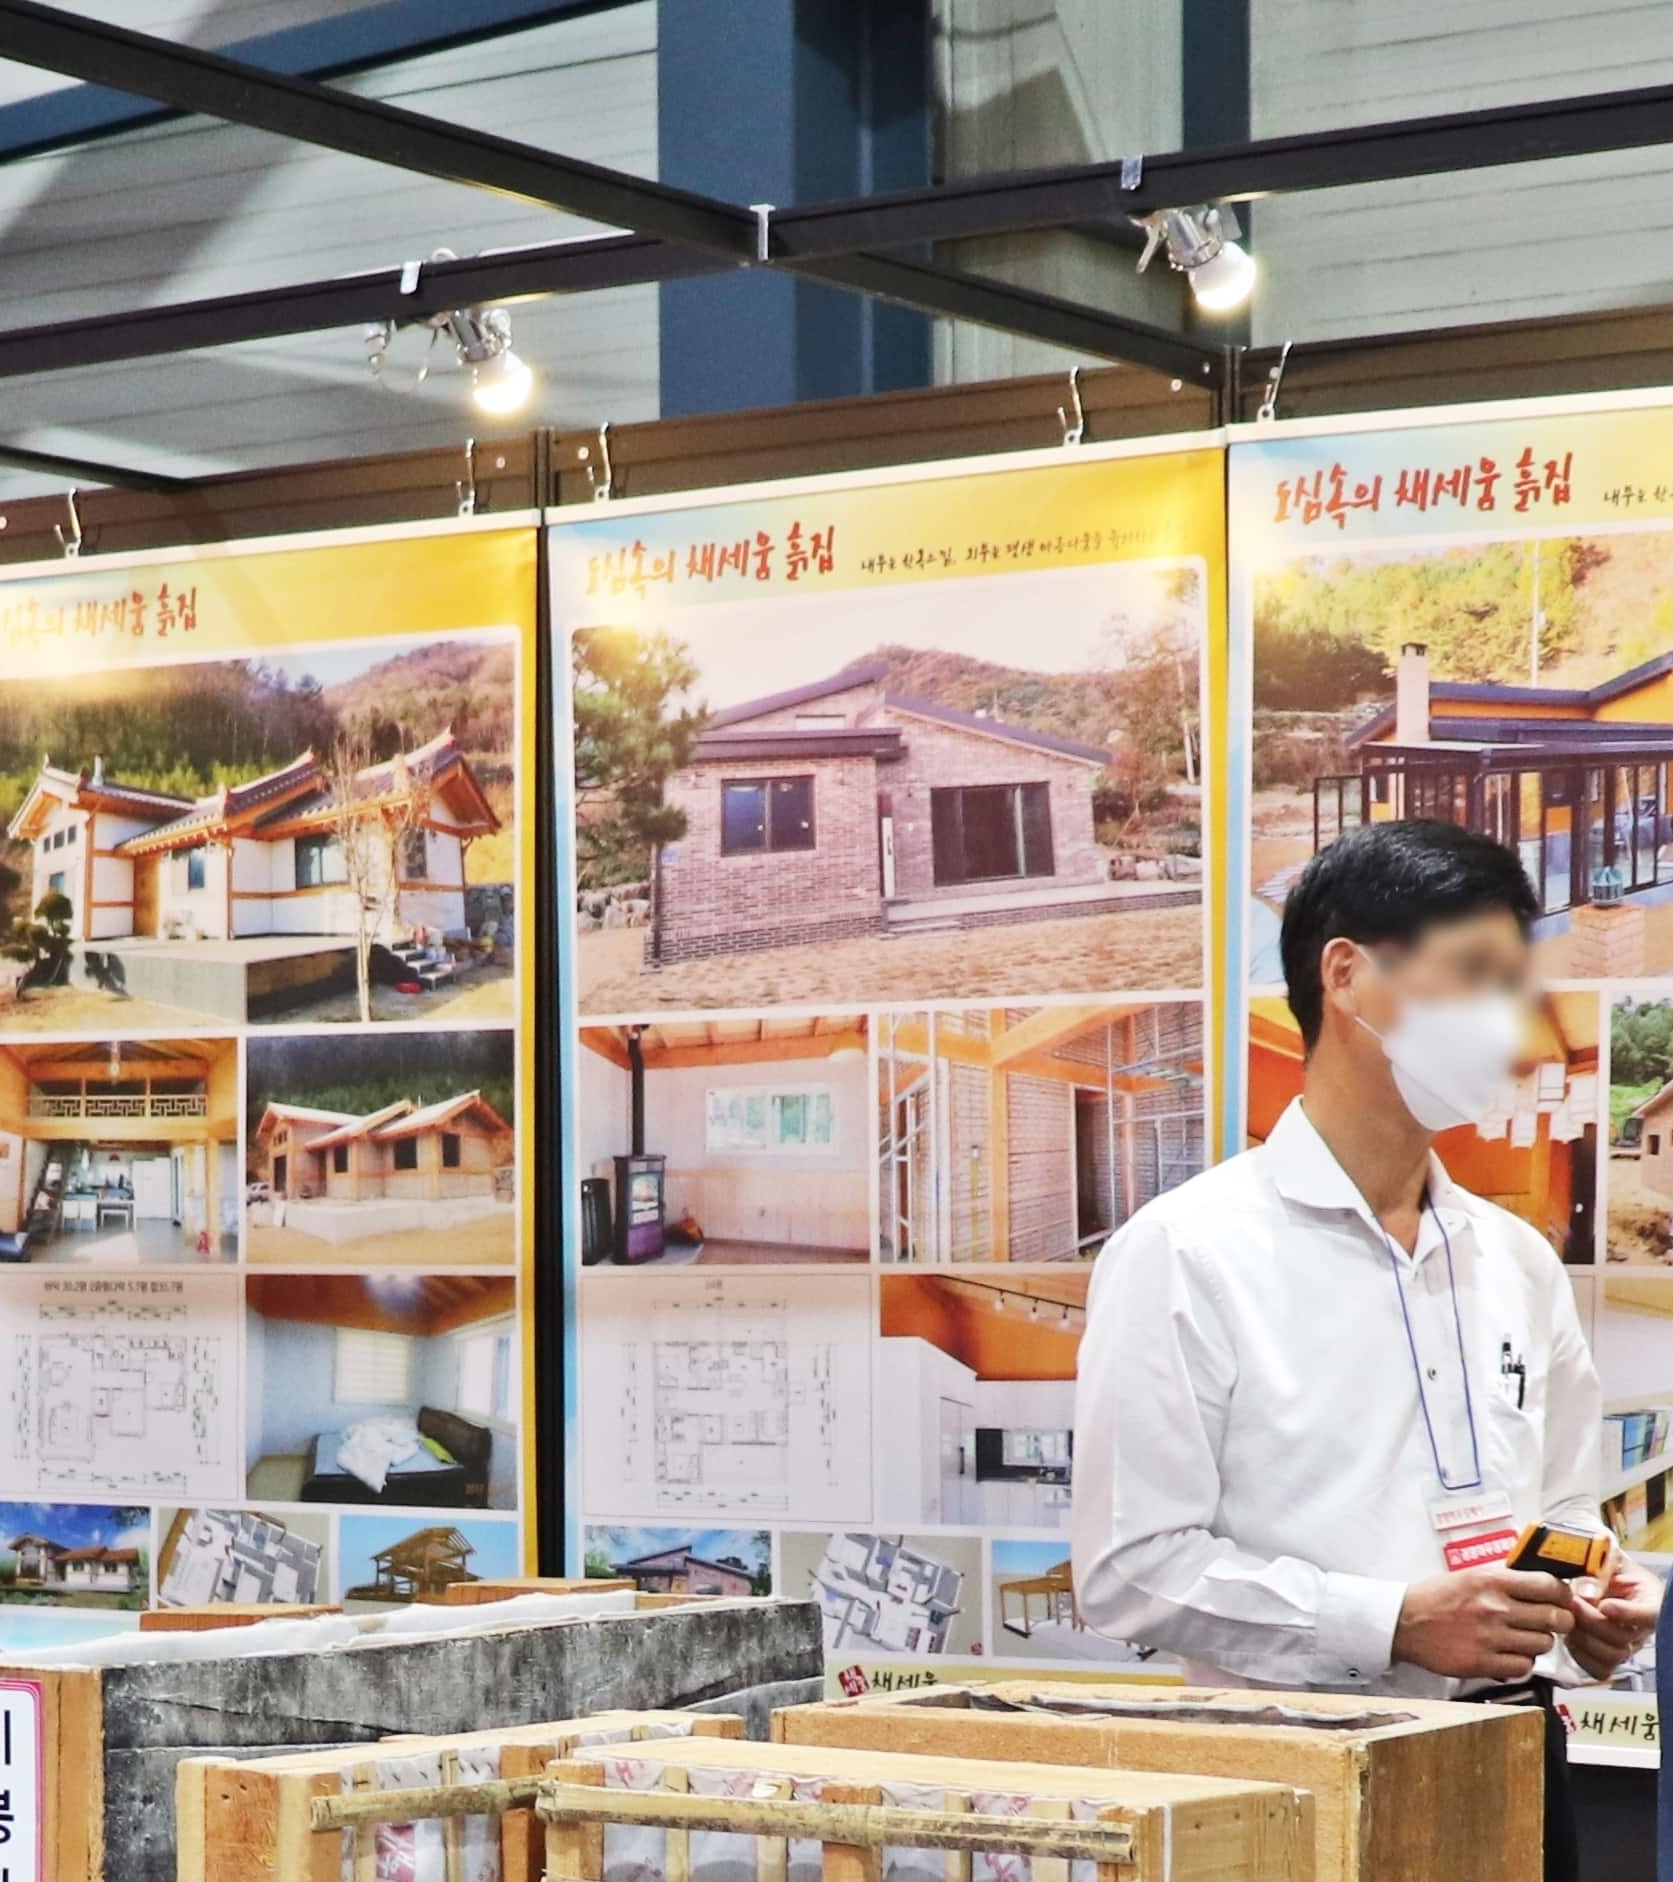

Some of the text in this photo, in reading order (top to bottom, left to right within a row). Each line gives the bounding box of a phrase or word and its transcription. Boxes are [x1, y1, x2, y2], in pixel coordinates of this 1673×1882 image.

[1274, 447, 1573, 529] 도심속의 채세움 흙집
[585, 521, 835, 600] 도심속의 채세움 흙집
[75, 590, 147, 638] 채세움
[157, 582, 198, 637] 흙집
[1580, 1711, 1661, 1741] 채세움
